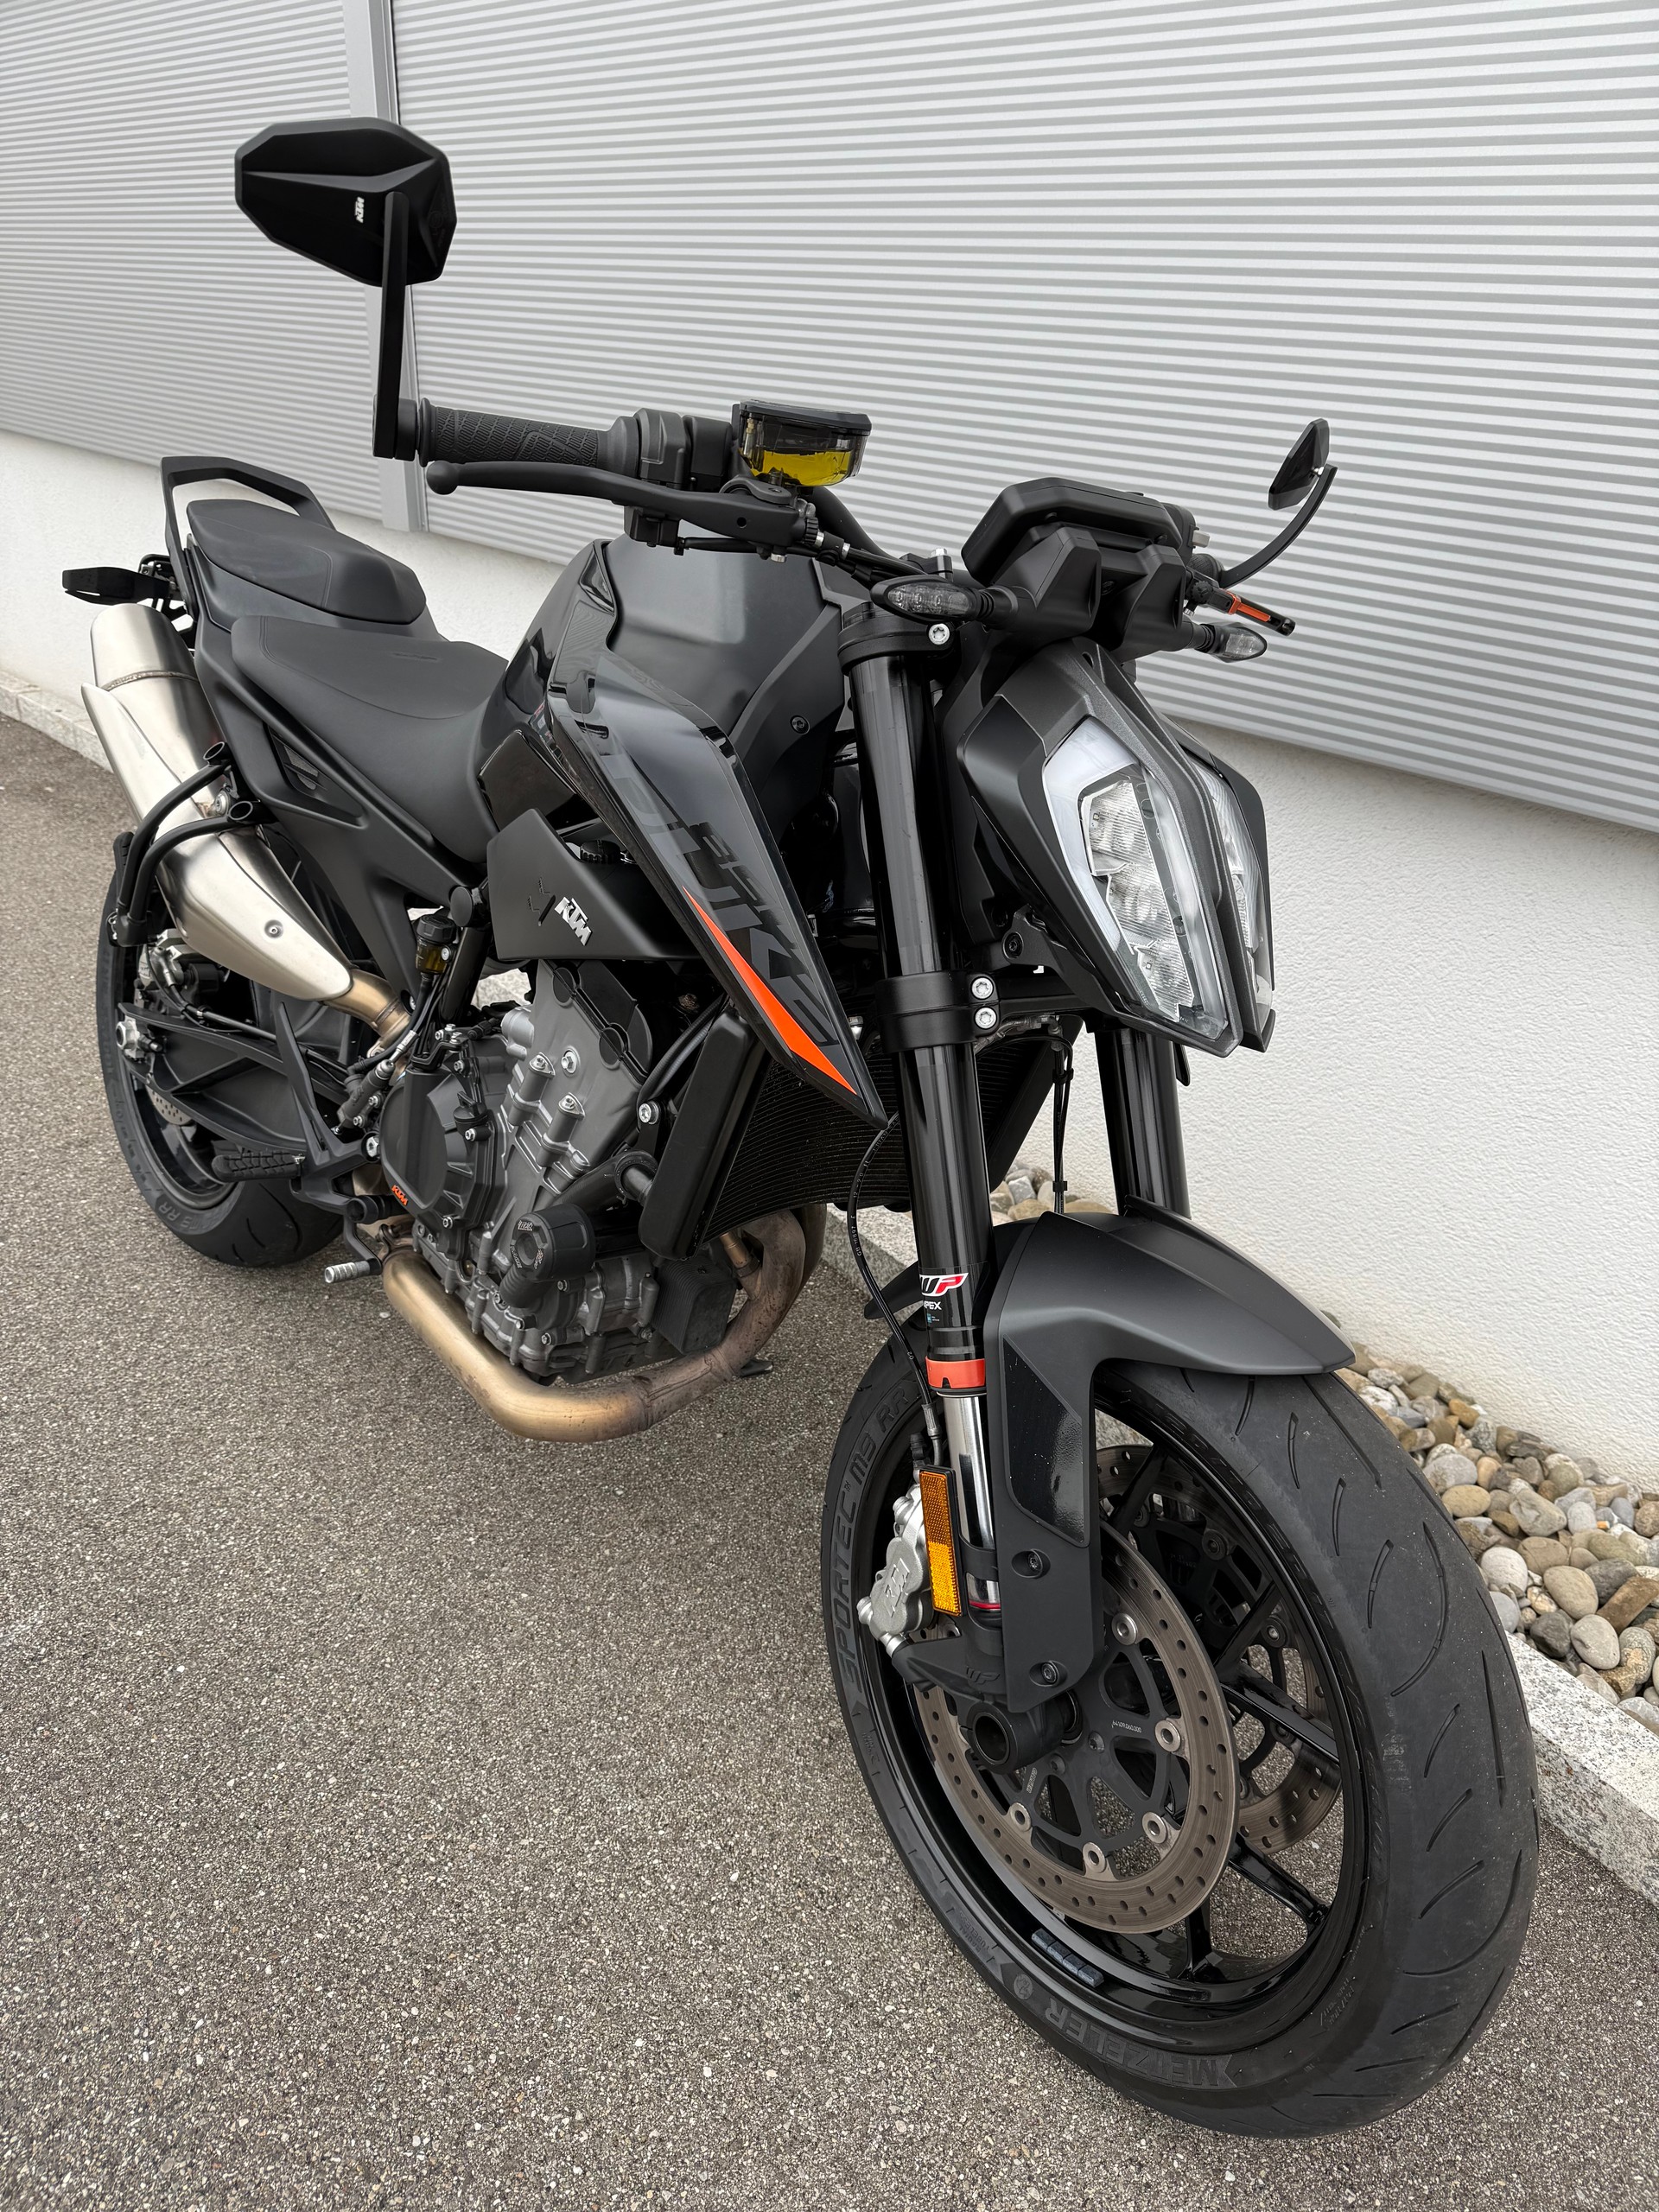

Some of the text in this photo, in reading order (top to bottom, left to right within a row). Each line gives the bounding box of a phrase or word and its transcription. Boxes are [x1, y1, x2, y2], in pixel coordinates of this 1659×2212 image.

[354, 196, 365, 223] KTM
[554, 896, 592, 947] KTM
[600, 753, 838, 1044] DUKE
[391, 1185, 409, 1206] KTM
[919, 1272, 969, 1297] WP
[833, 1389, 910, 1694] SPORTEC M9 RR
[1044, 1996, 1220, 2088] METZELER
